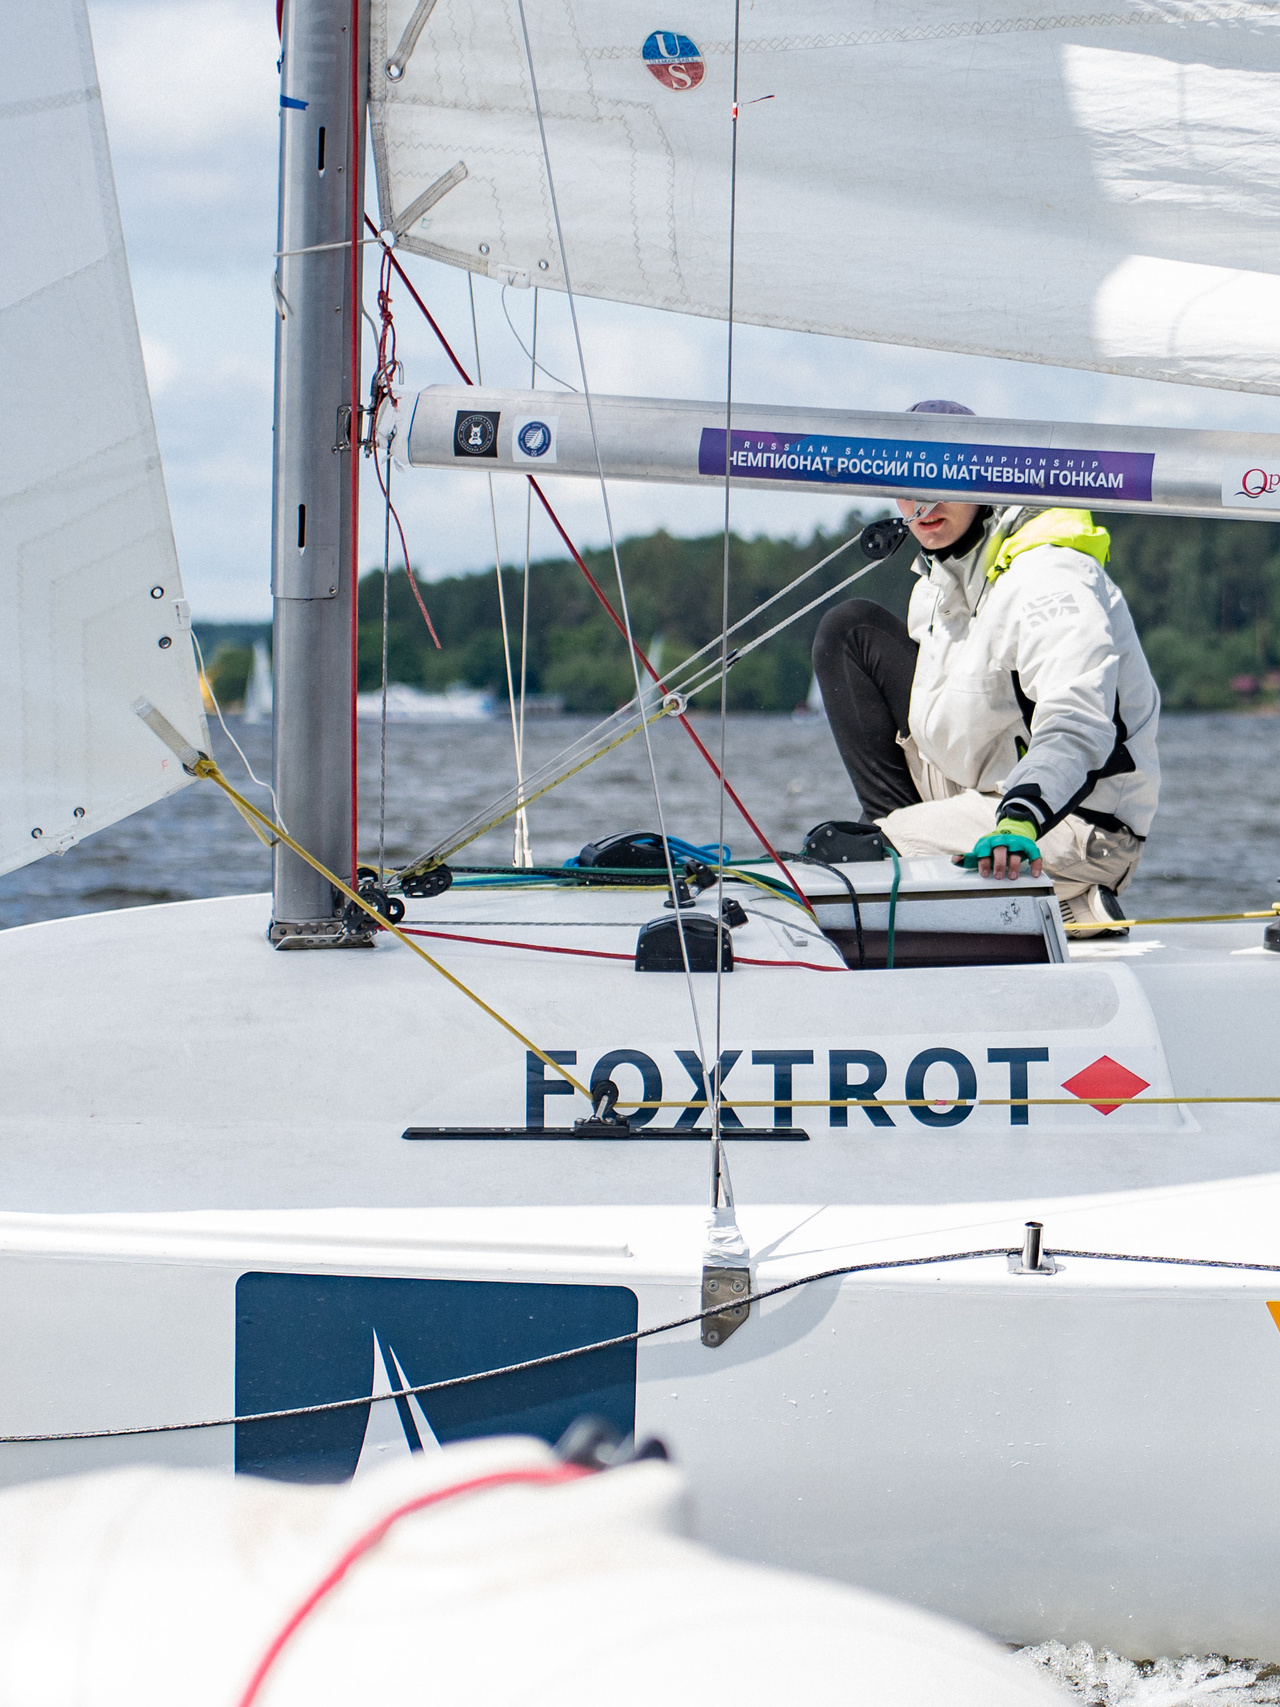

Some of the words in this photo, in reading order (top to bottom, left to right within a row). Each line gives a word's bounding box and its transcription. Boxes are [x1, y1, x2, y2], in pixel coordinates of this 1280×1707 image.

[654, 34, 680, 58] U
[668, 64, 692, 89] S
[744, 441, 828, 454] RUSSIAN
[845, 447, 926, 460] SAILING
[943, 453, 1099, 469] CHAMPIONSHIP
[837, 458, 908, 477] РОССИИ
[913, 462, 938, 479] ПО
[942, 464, 1045, 486] МАТЧЕВЫМ
[1050, 470, 1124, 489] ГОНКАМ
[525, 1047, 1050, 1130] FOXTROT
